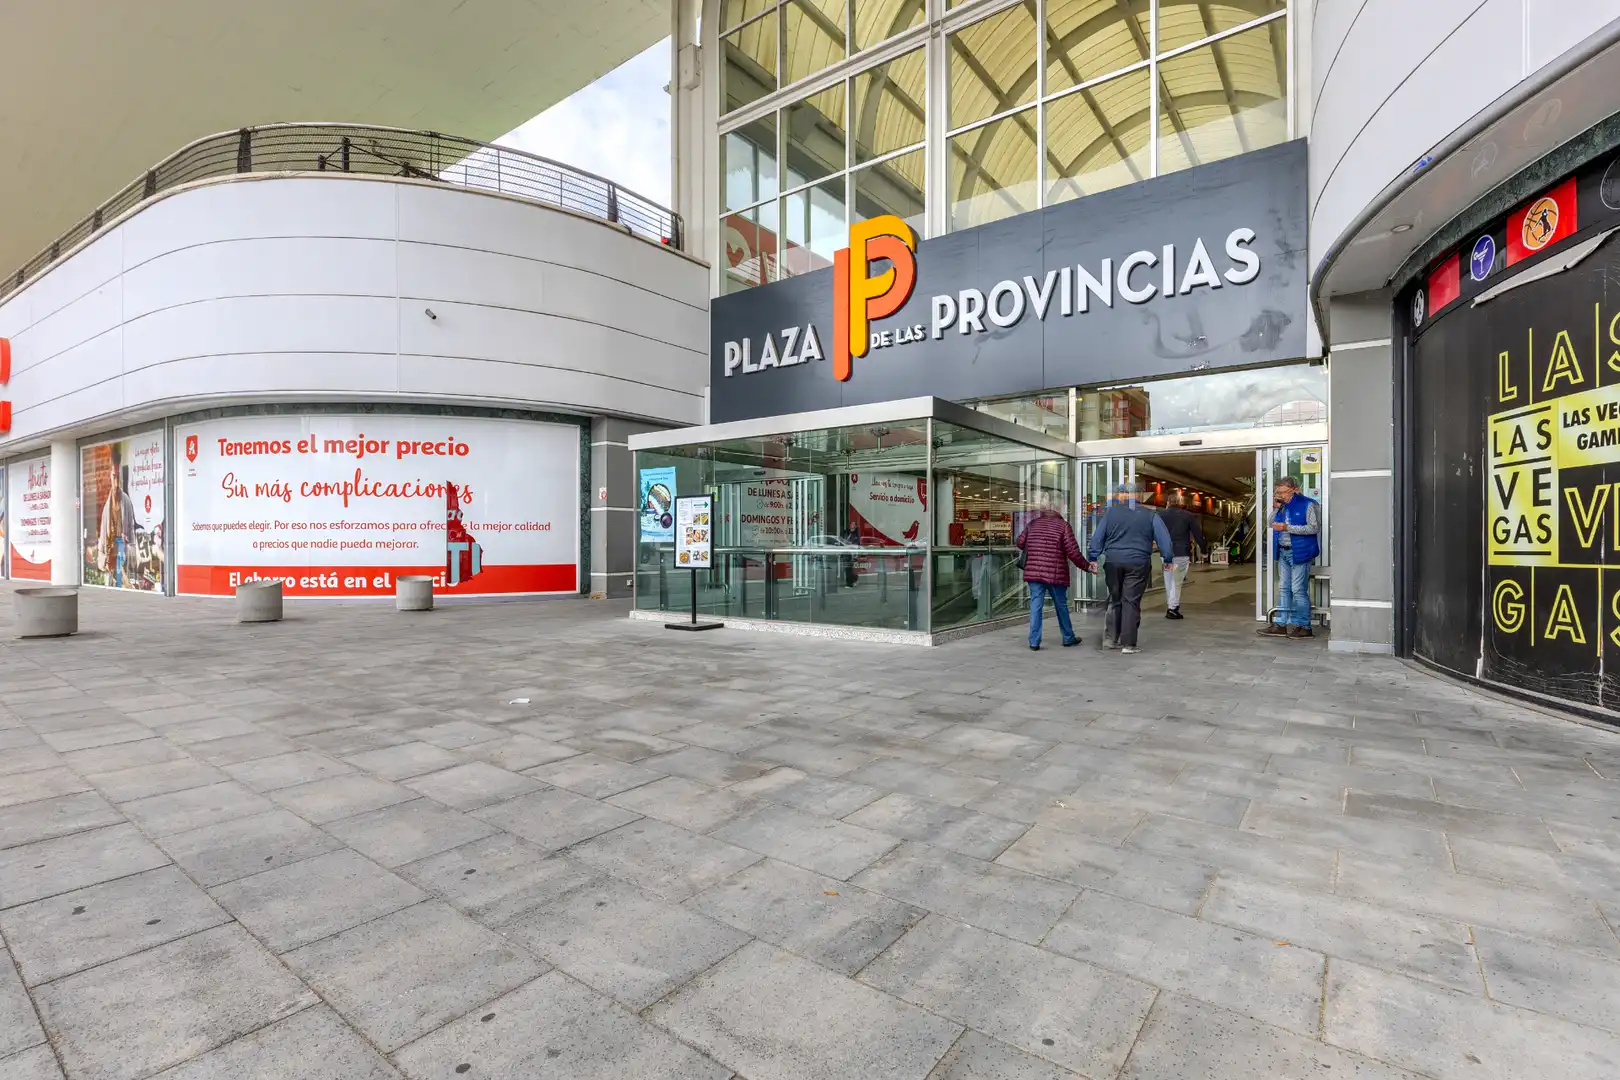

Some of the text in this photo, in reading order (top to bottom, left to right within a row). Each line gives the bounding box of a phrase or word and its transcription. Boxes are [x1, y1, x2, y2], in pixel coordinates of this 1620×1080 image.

[725, 227, 1261, 377] PLAZA DE LAS PROVINCIAS
[1563, 402, 1620, 428] LAS VE
[218, 433, 470, 460] Tenemos el mejor precio
[1493, 419, 1551, 458] LAS
[1577, 428, 1620, 450] GAM
[222, 472, 249, 498] Sin
[255, 479, 292, 503] más
[748, 487, 757, 496] DE
[758, 488, 780, 498] LUNES
[781, 490, 786, 498] A
[1494, 467, 1551, 510] VE
[192, 521, 212, 531] Sabemos
[212, 523, 222, 532] que
[223, 520, 247, 532] puedes
[248, 520, 272, 533] elegir.
[274, 520, 289, 530] Por
[291, 522, 308, 530] eso
[309, 522, 327, 530] nos
[329, 520, 390, 531] esforzamos
[392, 522, 417, 532] para
[470, 521, 480, 531] la
[482, 521, 513, 533] mejor
[515, 522, 551, 531] calidad
[741, 514, 779, 524] DOMINGOS
[780, 516, 785, 524] Y
[1493, 513, 1552, 544] GAS
[259, 539, 290, 551] precios
[291, 541, 308, 550] que
[310, 539, 338, 549] nadie
[340, 539, 373, 550] pueda
[375, 539, 419, 551] mejorar.
[229, 571, 240, 587] El
[300, 572, 339, 588] está
[344, 575, 367, 588] en
[371, 572, 391, 588] el
